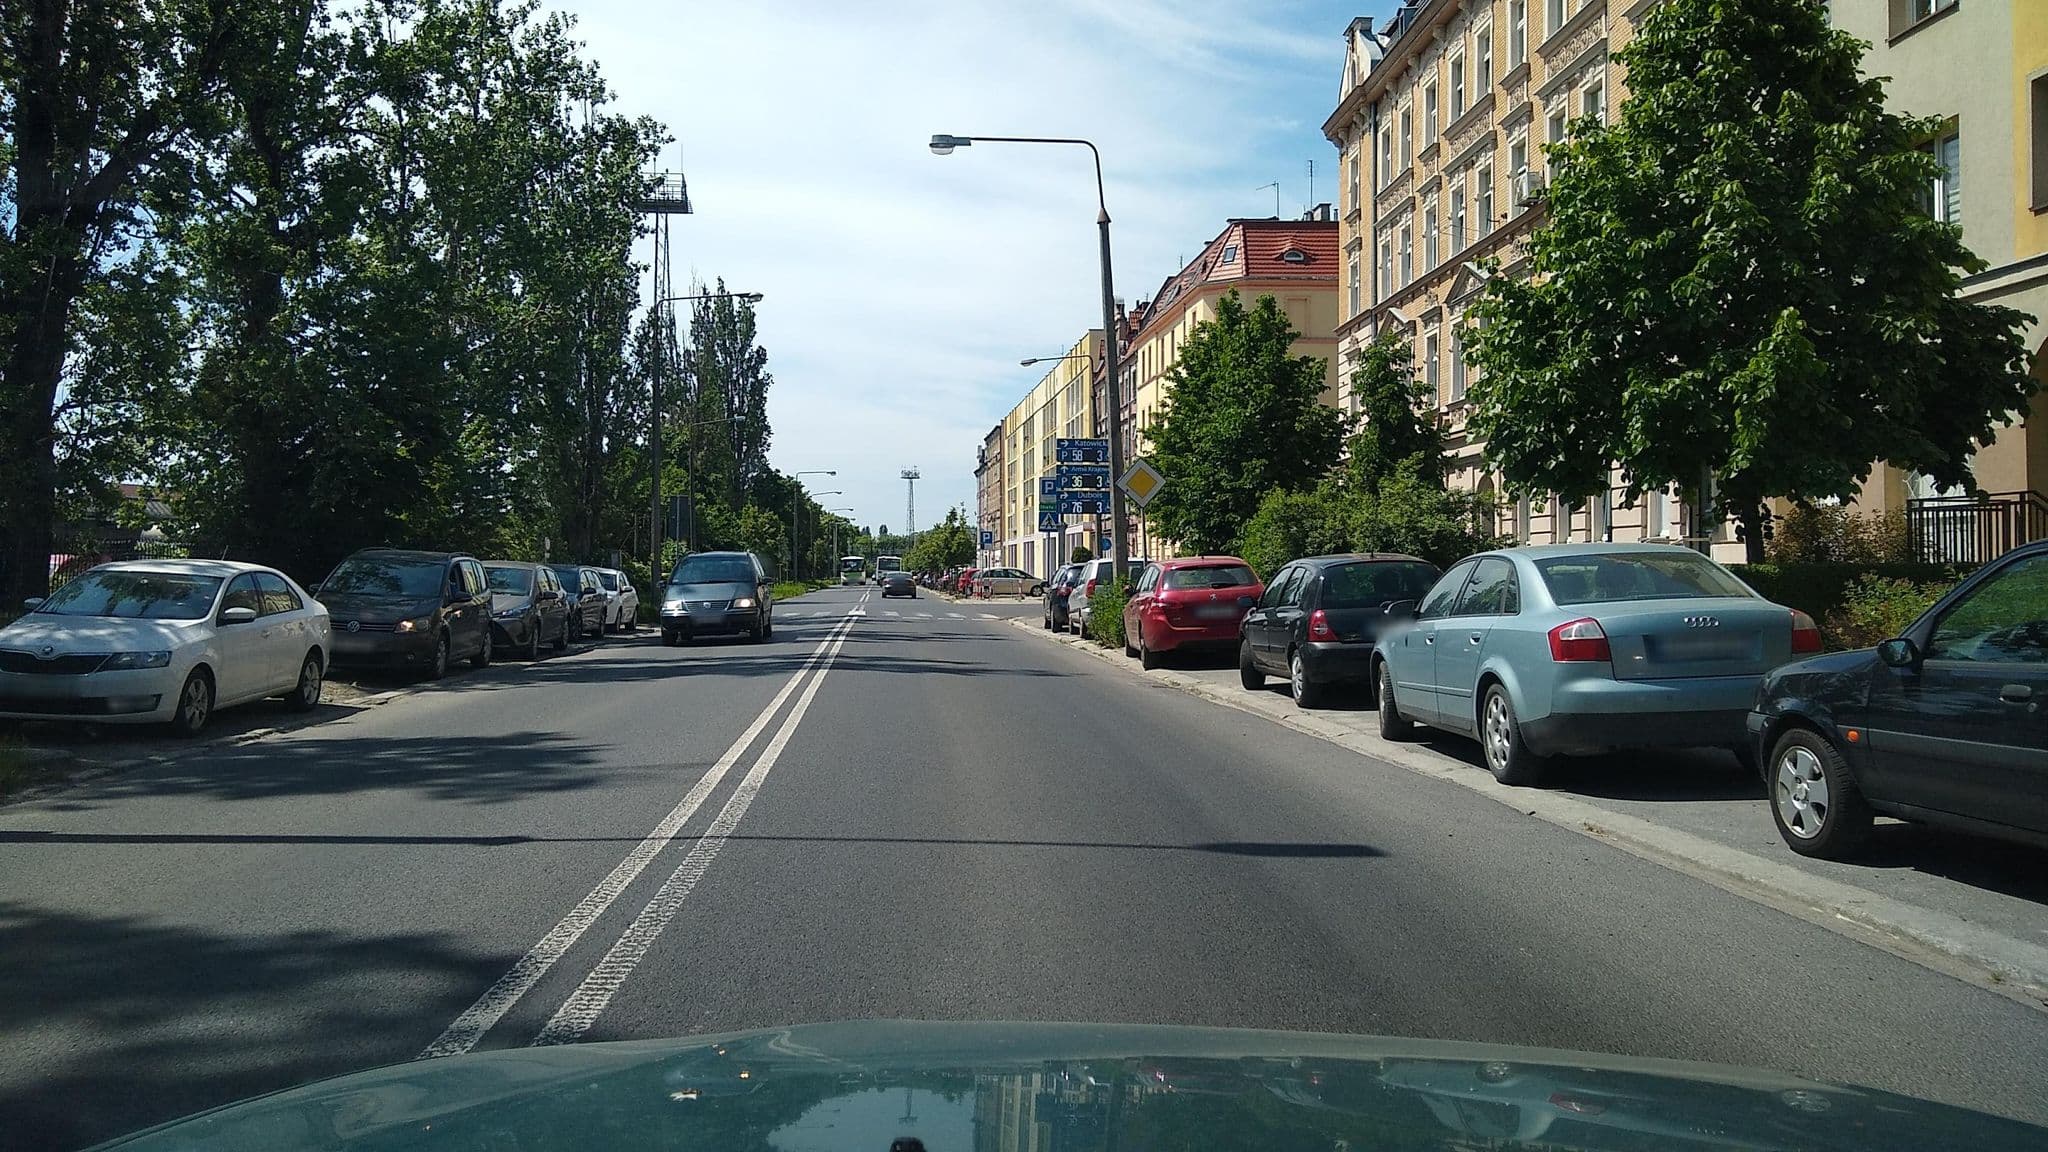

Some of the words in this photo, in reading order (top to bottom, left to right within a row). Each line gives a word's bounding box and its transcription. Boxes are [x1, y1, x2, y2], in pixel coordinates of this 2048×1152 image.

[1062, 451, 1068, 460] P
[1072, 450, 1083, 461] 58
[1096, 450, 1103, 461] 3
[1045, 481, 1054, 493] P
[1062, 477, 1068, 486] P
[1072, 476, 1083, 487] 36
[1096, 476, 1103, 487] 3
[1061, 503, 1068, 512] P
[1072, 502, 1083, 513] 76
[1096, 502, 1103, 513] 3
[983, 532, 991, 542] P
